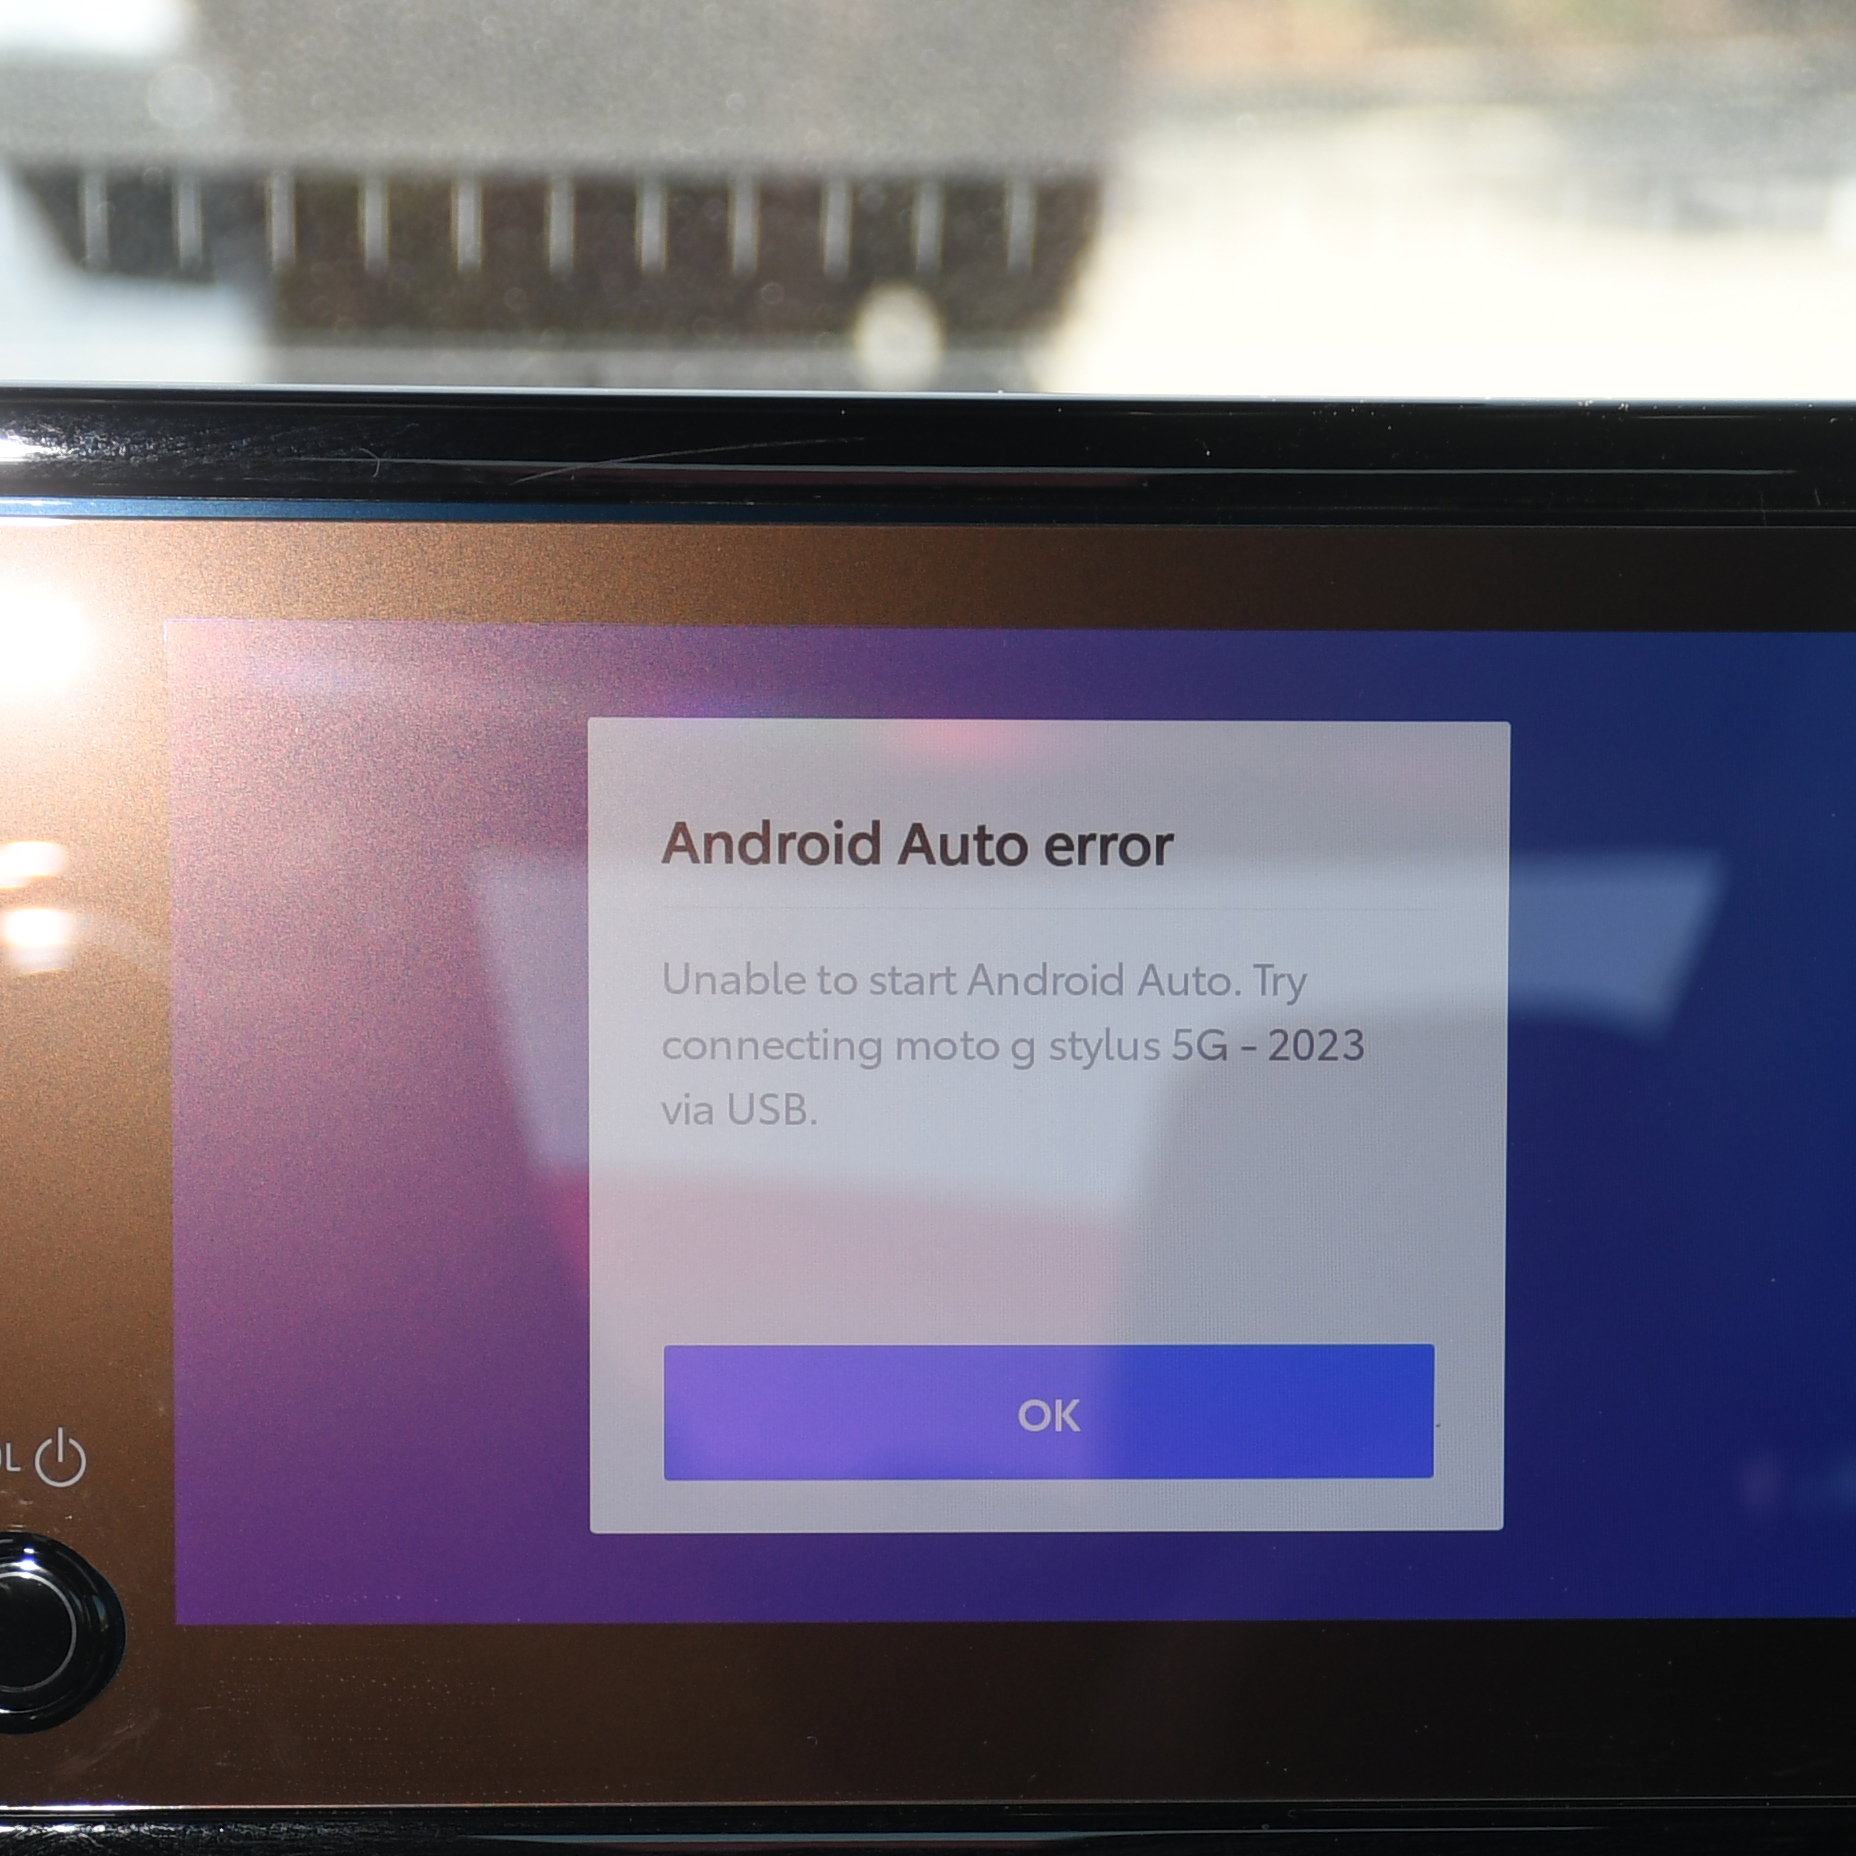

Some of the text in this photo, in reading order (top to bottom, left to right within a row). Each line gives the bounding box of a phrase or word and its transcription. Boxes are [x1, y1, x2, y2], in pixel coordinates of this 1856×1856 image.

[661, 820, 1175, 867] Android Auto error
[662, 960, 1308, 1006] Unable to start Android Auto. Try
[661, 1027, 883, 1070] connecting
[895, 1029, 1000, 1062] moto
[1010, 1036, 1036, 1070] g
[1049, 1027, 1161, 1071] stylus
[1171, 1028, 1229, 1063] 5G
[1267, 1027, 1366, 1063] 2023
[661, 1092, 818, 1127] via USB.
[1017, 1398, 1082, 1433] OK
